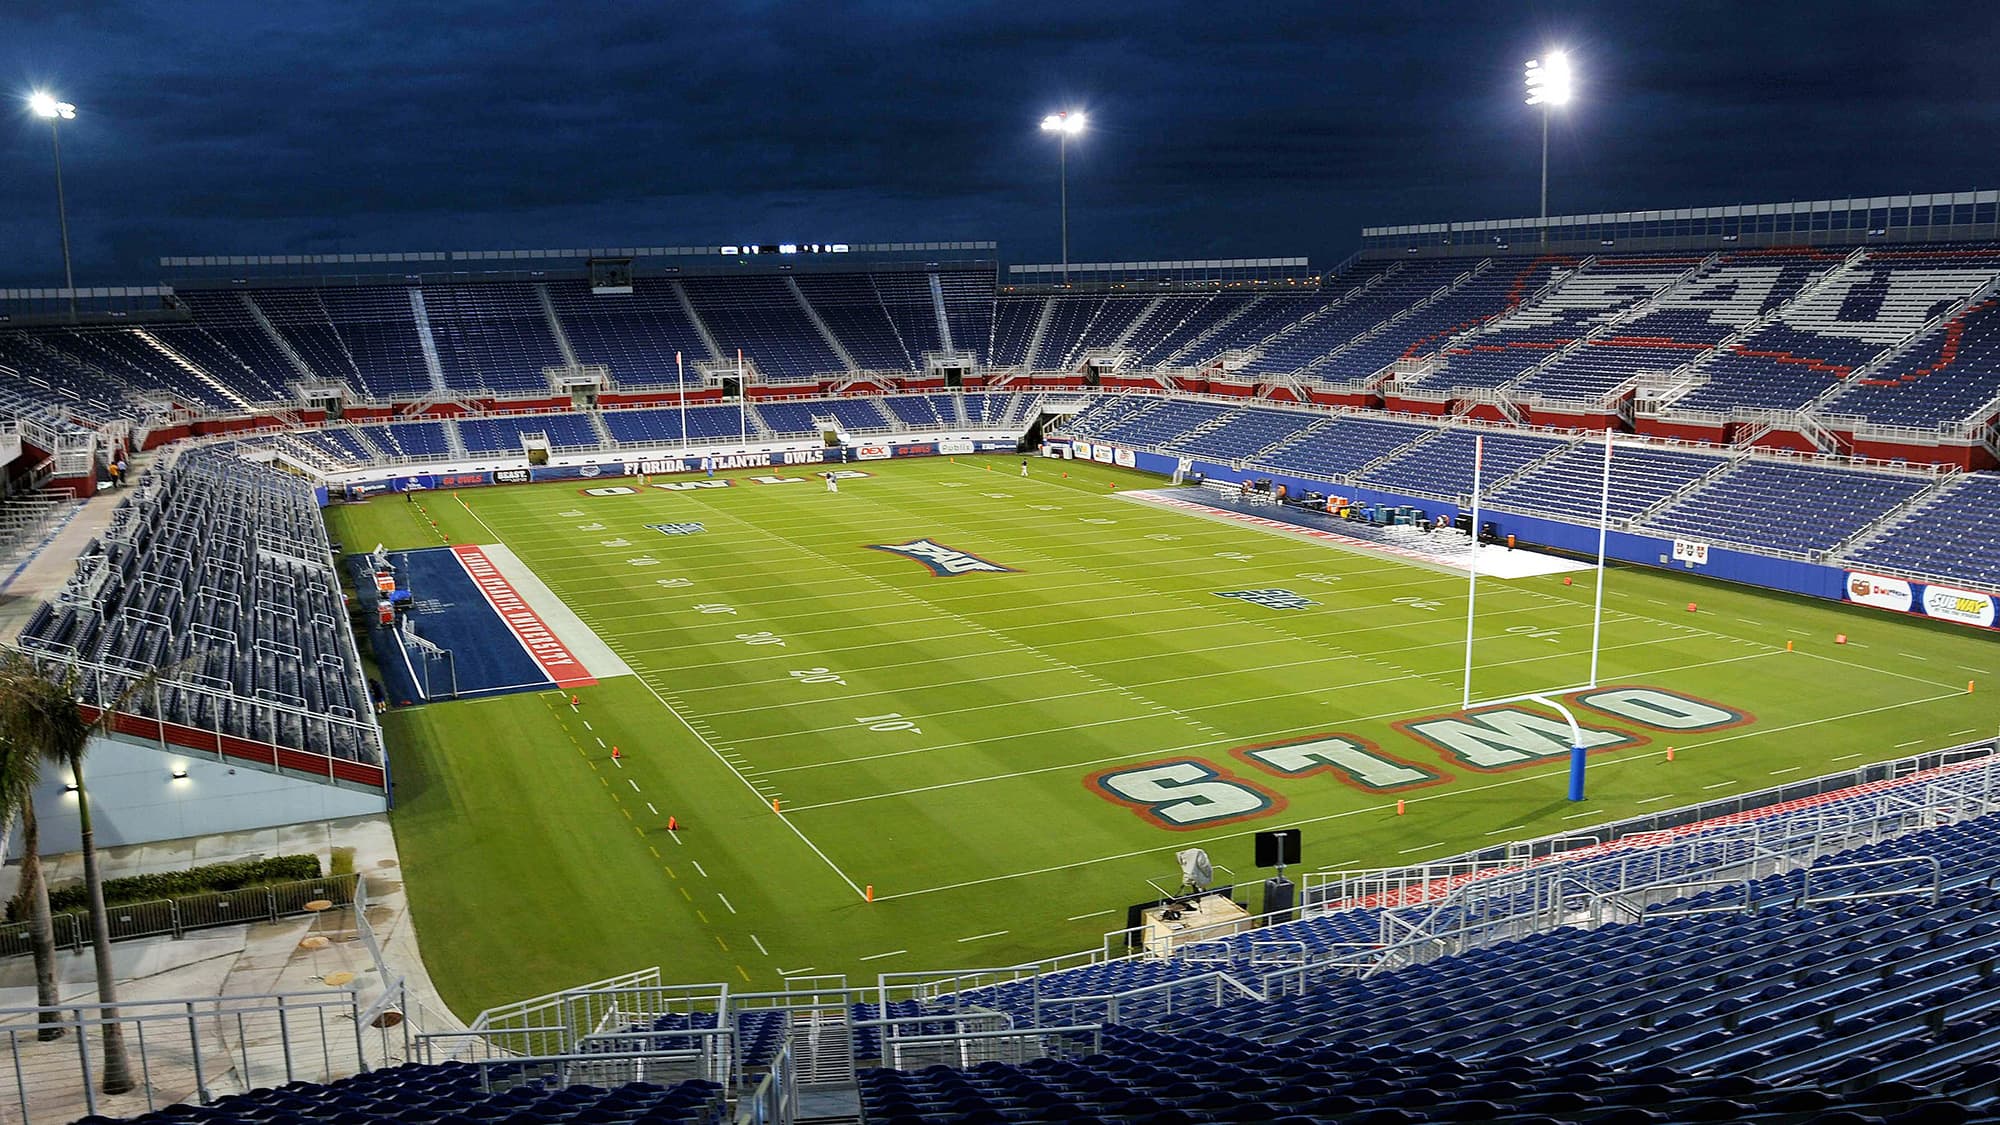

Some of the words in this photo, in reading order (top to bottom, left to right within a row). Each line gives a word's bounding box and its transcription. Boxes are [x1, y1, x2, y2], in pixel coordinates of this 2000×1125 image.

[1490, 266, 2000, 345] FAU
[700, 453, 770, 470] ATLANTIC
[784, 450, 823, 465] OWLS
[861, 447, 884, 456] DEX
[580, 469, 872, 497] OWLS
[692, 602, 734, 614] 40
[1929, 593, 1988, 613] SUBWAY
[505, 612, 576, 666] UNIVERSITY
[735, 631, 782, 646] 30
[1505, 625, 1562, 638] 10
[789, 667, 841, 685] 20
[855, 713, 915, 732] 10
[1092, 687, 1750, 828] OWLS
